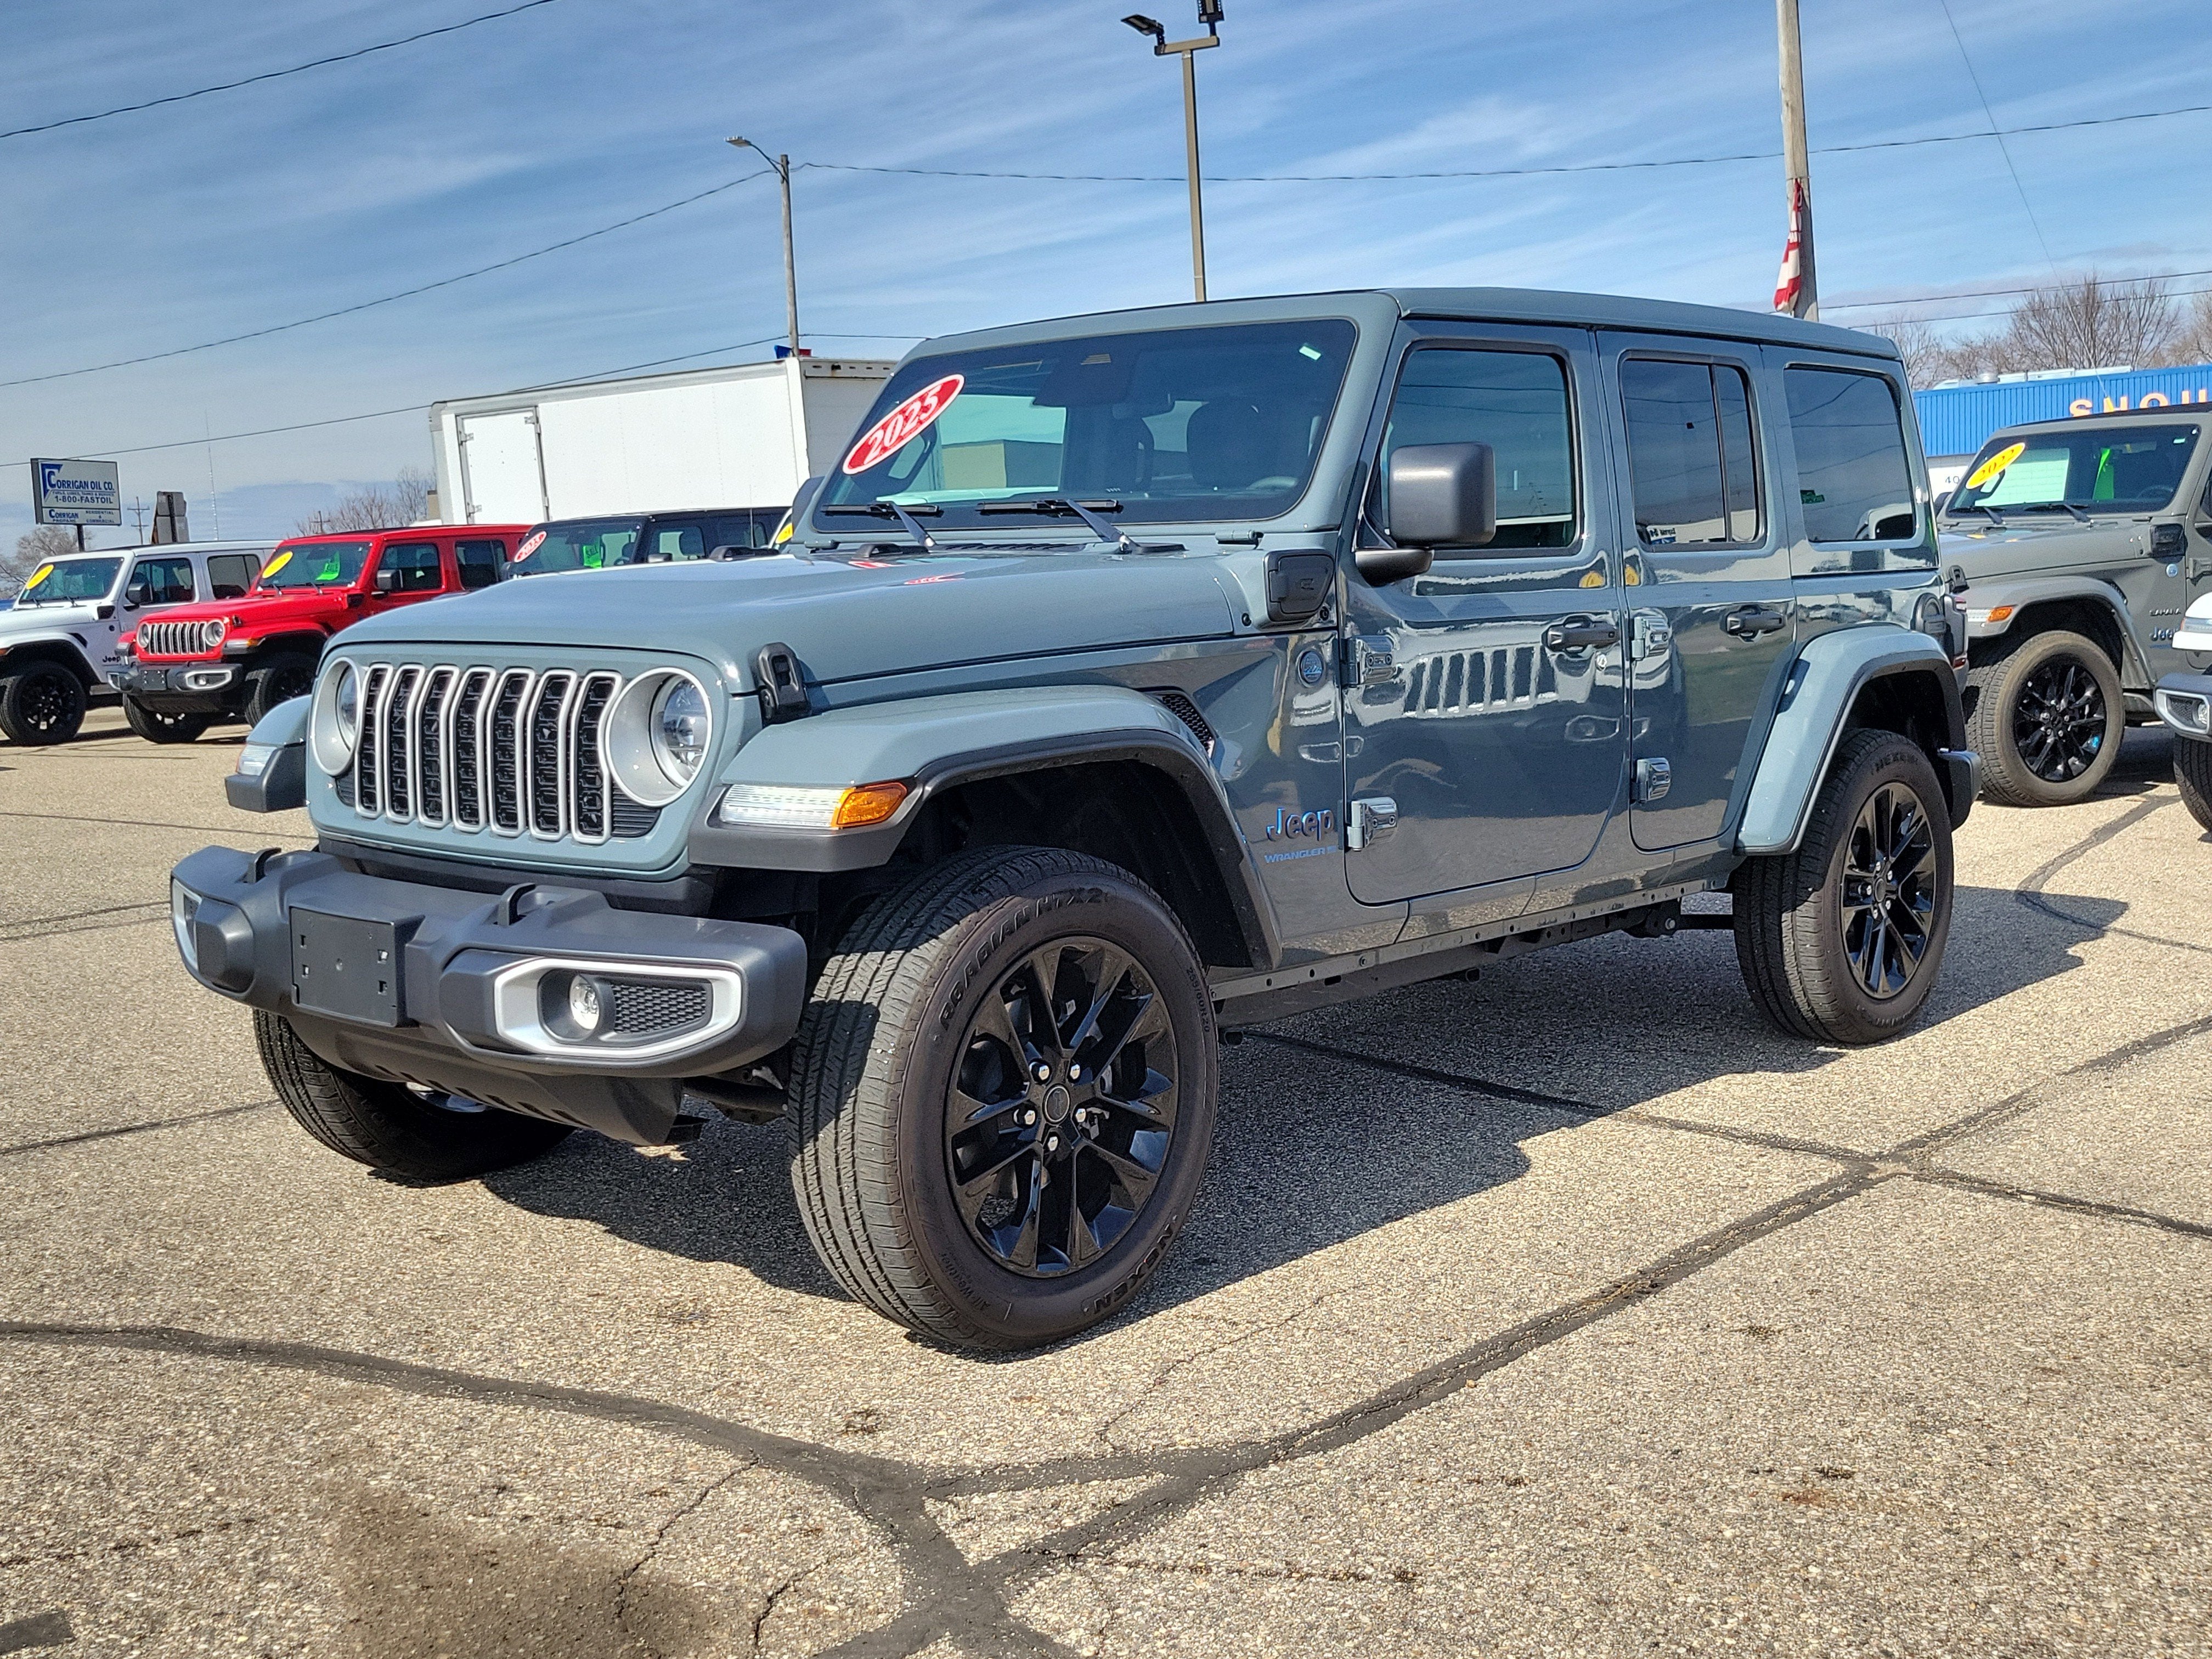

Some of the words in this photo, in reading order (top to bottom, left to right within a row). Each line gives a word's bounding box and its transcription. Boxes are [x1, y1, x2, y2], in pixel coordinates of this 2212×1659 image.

[863, 383, 943, 465] 2025
[47, 470, 89, 490] CORRIGAN
[90, 481, 102, 490] OIL
[103, 481, 115, 491] CO.
[55, 495, 114, 504] 1-800-FASTOIL
[48, 509, 79, 519] CORRIGAN
[1266, 806, 1334, 842] Jeep
[1264, 847, 1325, 864] WRANGLER
[1094, 1222, 1173, 1314] NEXEN
